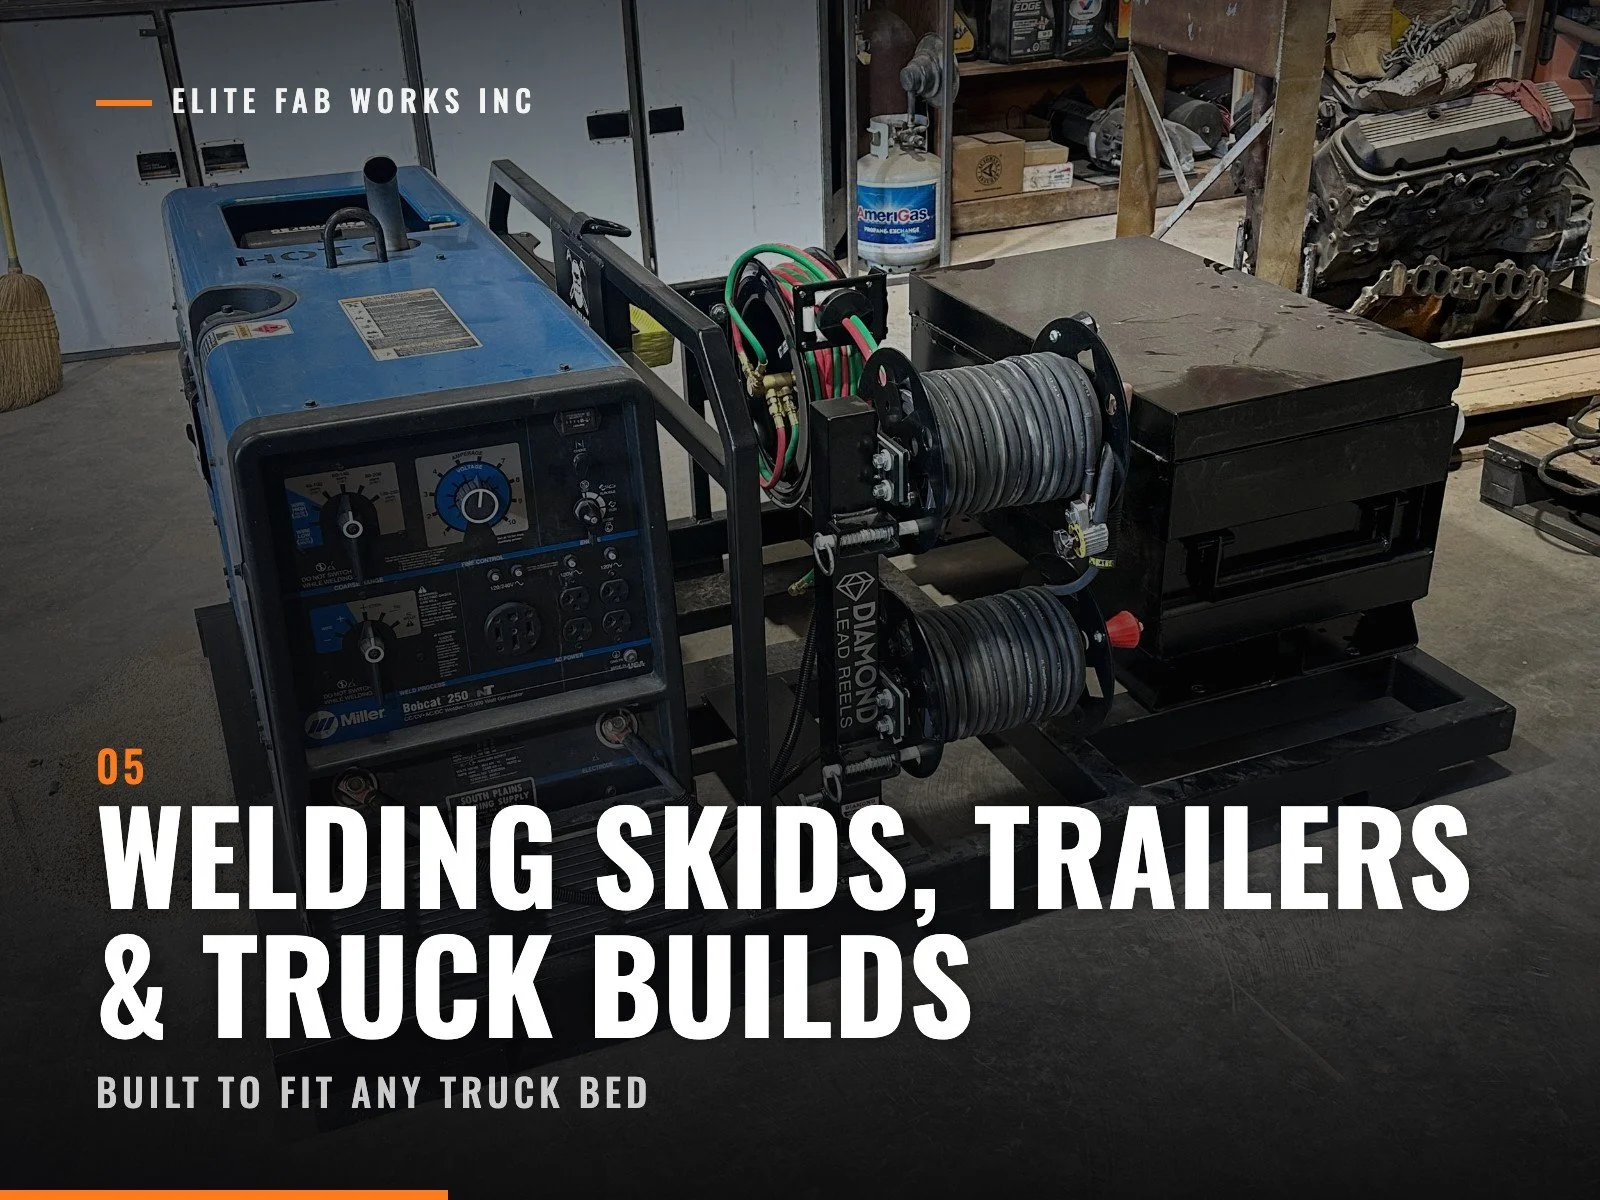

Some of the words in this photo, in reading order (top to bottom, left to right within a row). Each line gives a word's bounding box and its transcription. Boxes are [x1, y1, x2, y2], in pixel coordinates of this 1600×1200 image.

[1013, 2, 1041, 12] EDGE
[857, 205, 928, 222] AmeriGas
[456, 464, 483, 473] VOLTAGE
[475, 554, 504, 565] CONTROL
[301, 575, 312, 583] DO
[313, 572, 326, 581] NOT
[836, 607, 850, 659] LEAD
[852, 601, 879, 724] DIAMOND
[402, 696, 442, 714] Bobcat
[447, 691, 469, 704] 250
[838, 667, 853, 729] REELS
[340, 708, 385, 727] Miller
[460, 791, 490, 805] SOUTH
[493, 783, 523, 798] PLAINS
[498, 791, 530, 806] SUPPLY
